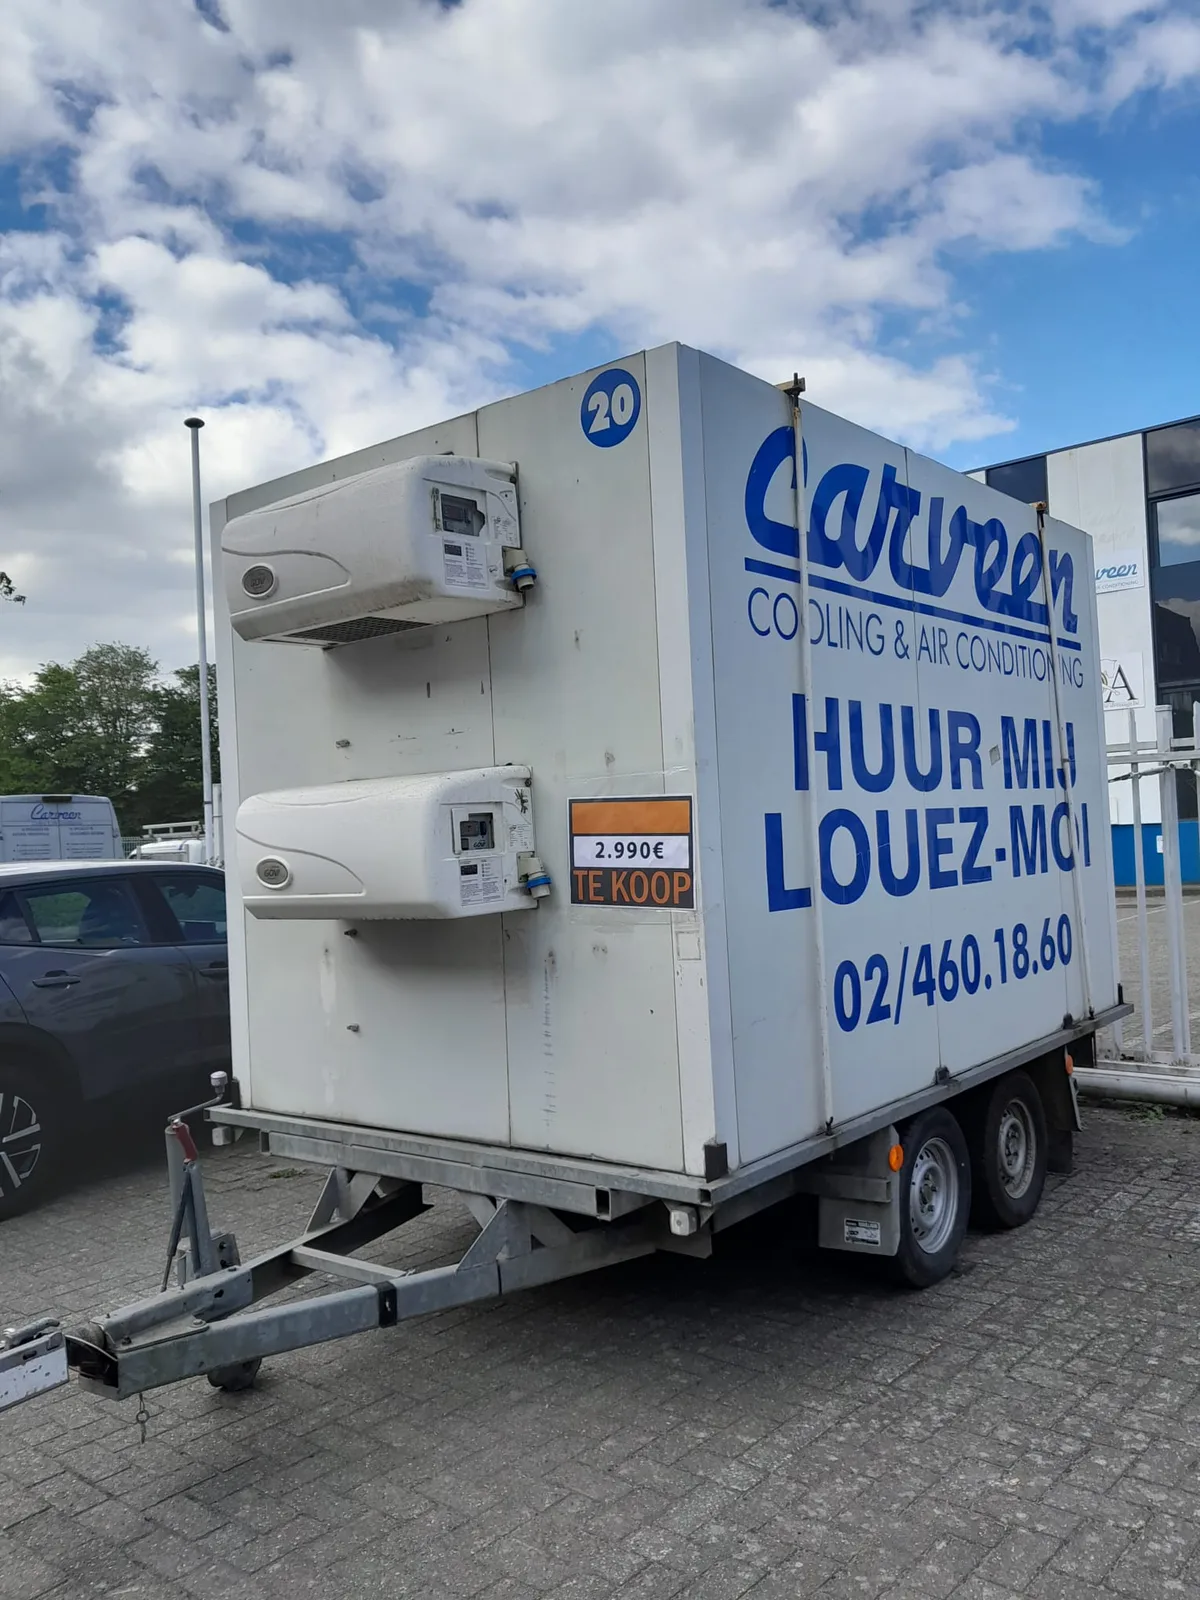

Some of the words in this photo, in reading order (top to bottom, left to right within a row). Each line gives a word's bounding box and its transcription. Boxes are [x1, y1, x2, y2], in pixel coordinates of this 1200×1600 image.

[588, 383, 635, 434] 20
[745, 425, 1078, 634] Carveen
[1096, 563, 1137, 580] veen
[747, 587, 885, 656] COOLING
[894, 619, 910, 660] &
[917, 624, 950, 666] AIR
[595, 841, 664, 859] 2.990€
[764, 801, 1091, 912] LOUEZ-MOI
[573, 869, 605, 902] TE
[611, 870, 691, 904] KOOP
[834, 913, 1072, 1033] 02/460.18.60
